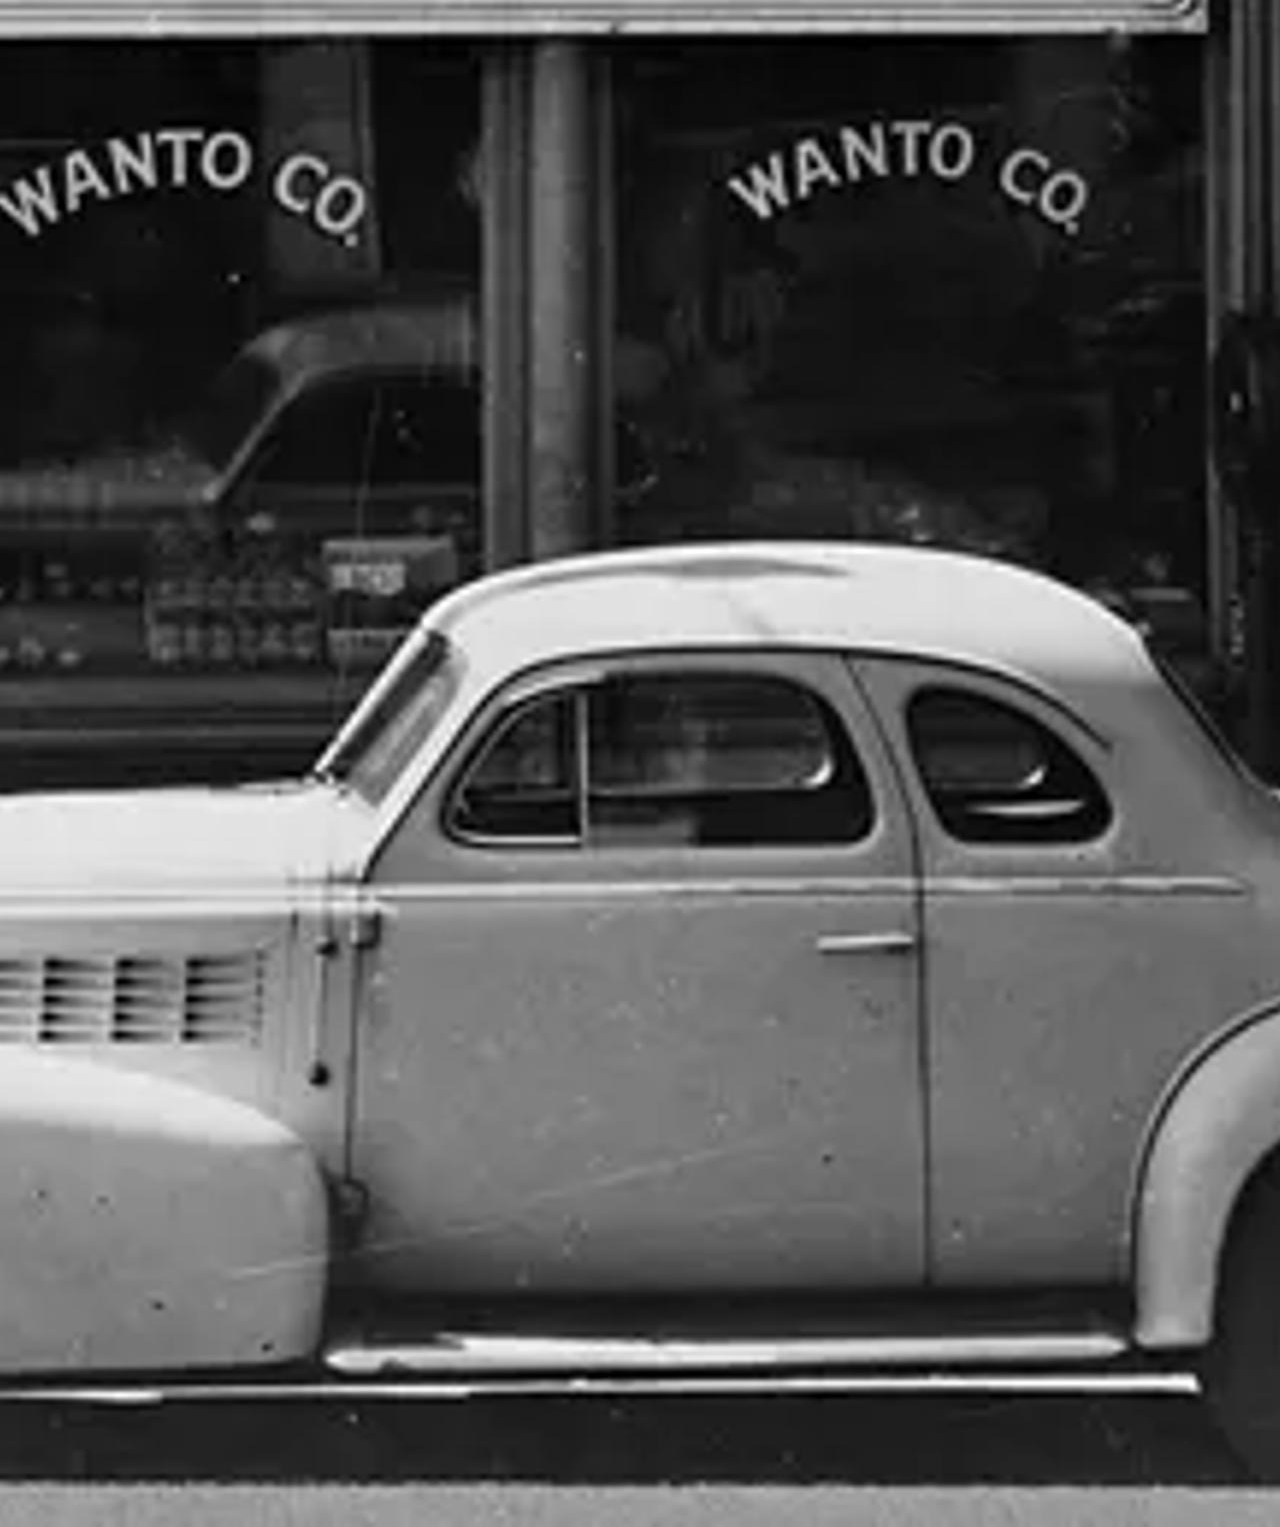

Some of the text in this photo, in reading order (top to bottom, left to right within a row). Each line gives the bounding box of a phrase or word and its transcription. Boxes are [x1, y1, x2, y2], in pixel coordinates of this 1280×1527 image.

[273, 153, 367, 247] CO.
[727, 120, 1088, 235] WANTO CO.
